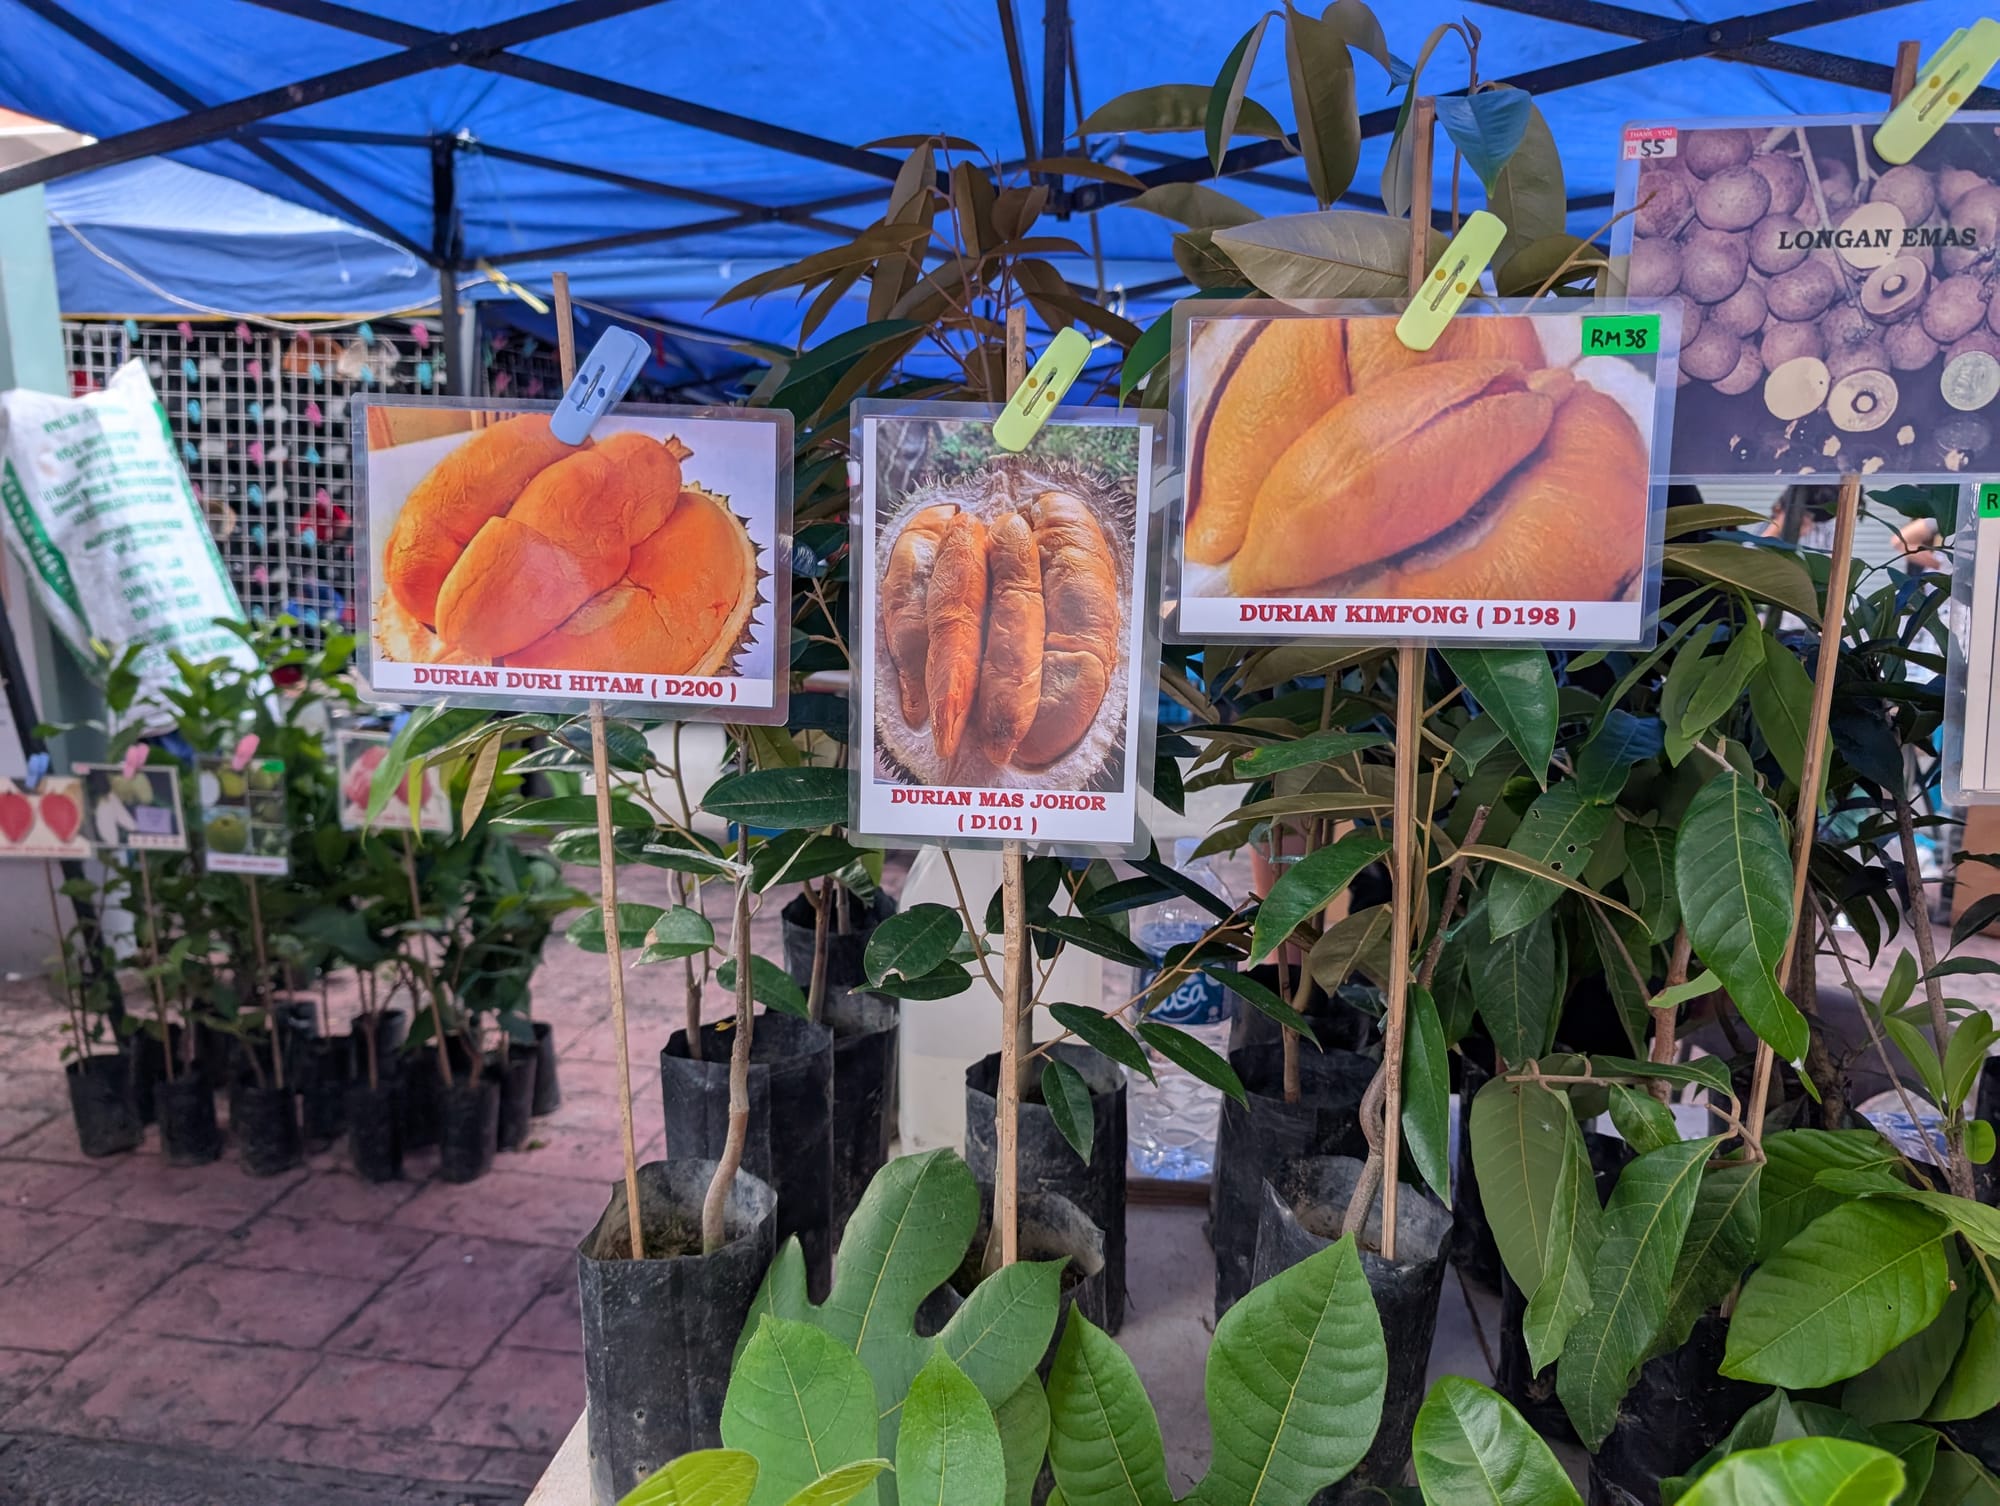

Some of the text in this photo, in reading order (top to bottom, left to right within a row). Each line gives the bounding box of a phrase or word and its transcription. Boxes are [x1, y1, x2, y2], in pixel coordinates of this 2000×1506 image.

[1657, 129, 1673, 137] YOU
[1777, 228, 1977, 250] LONGAN EMAS
[1239, 604, 1338, 622] DURIAN
[1344, 605, 1469, 624] KIMFONG
[413, 667, 499, 688] DURIAN
[506, 671, 562, 691] DURI
[568, 675, 644, 694] HITAM
[891, 789, 1107, 811] DURIAN MAS JOHOR
